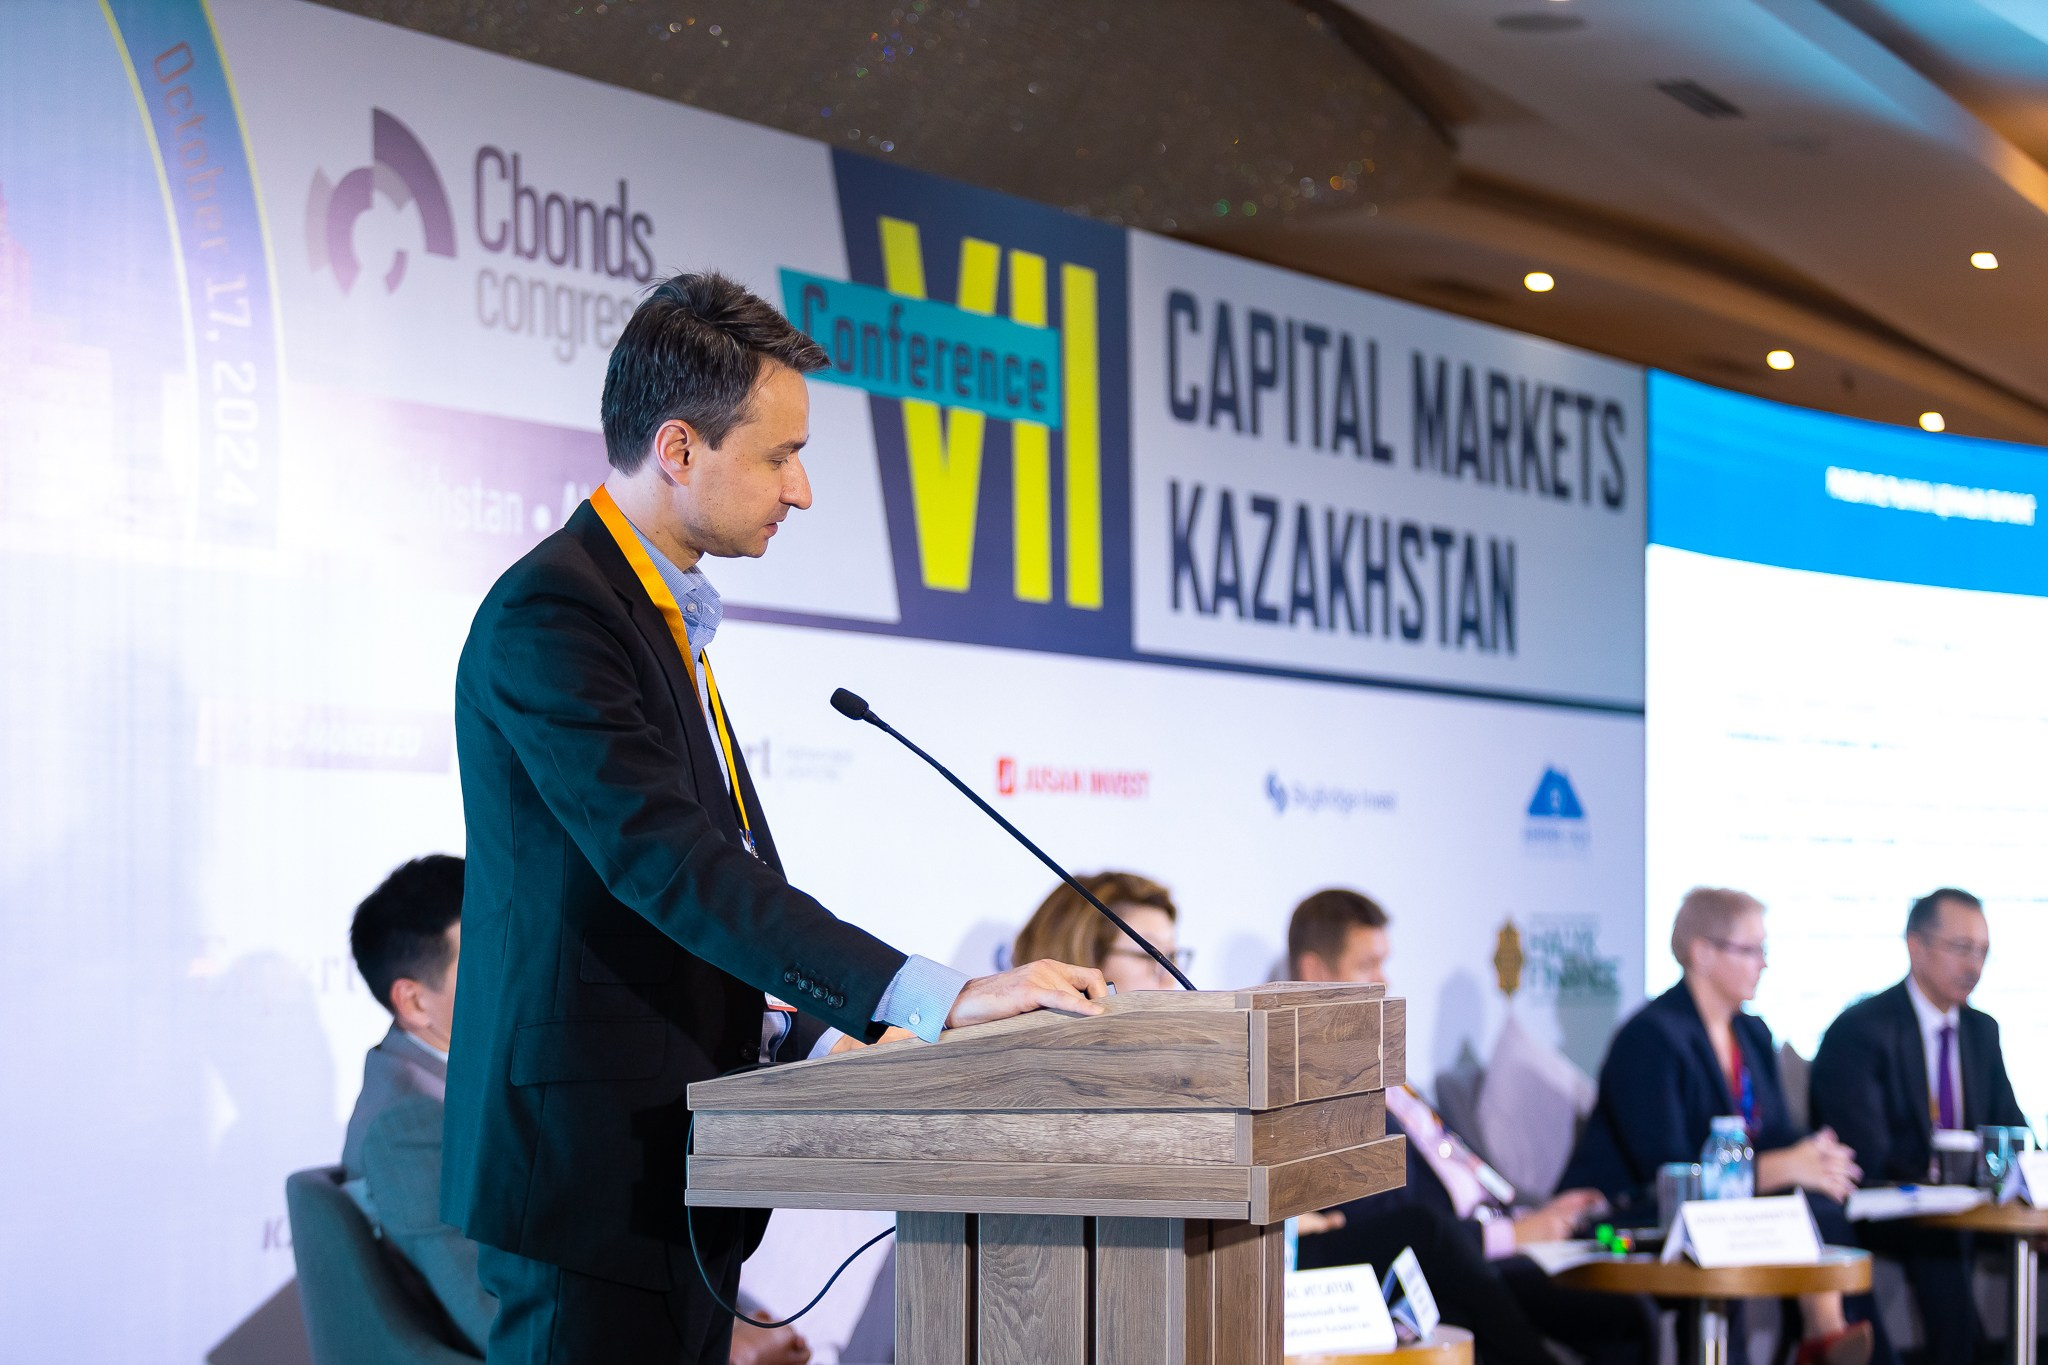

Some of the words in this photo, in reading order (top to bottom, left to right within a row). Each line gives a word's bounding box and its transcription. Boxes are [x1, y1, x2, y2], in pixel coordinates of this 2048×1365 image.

[153, 40, 229, 256] October
[212, 359, 259, 508] 2024
[474, 145, 655, 283] Cbonds
[803, 284, 1049, 413] Conference
[877, 214, 1104, 612] VII
[1165, 288, 1395, 464] CAPITAL
[1411, 347, 1628, 513] MARKETS
[1168, 478, 1519, 657] KAZAKHSTAN
